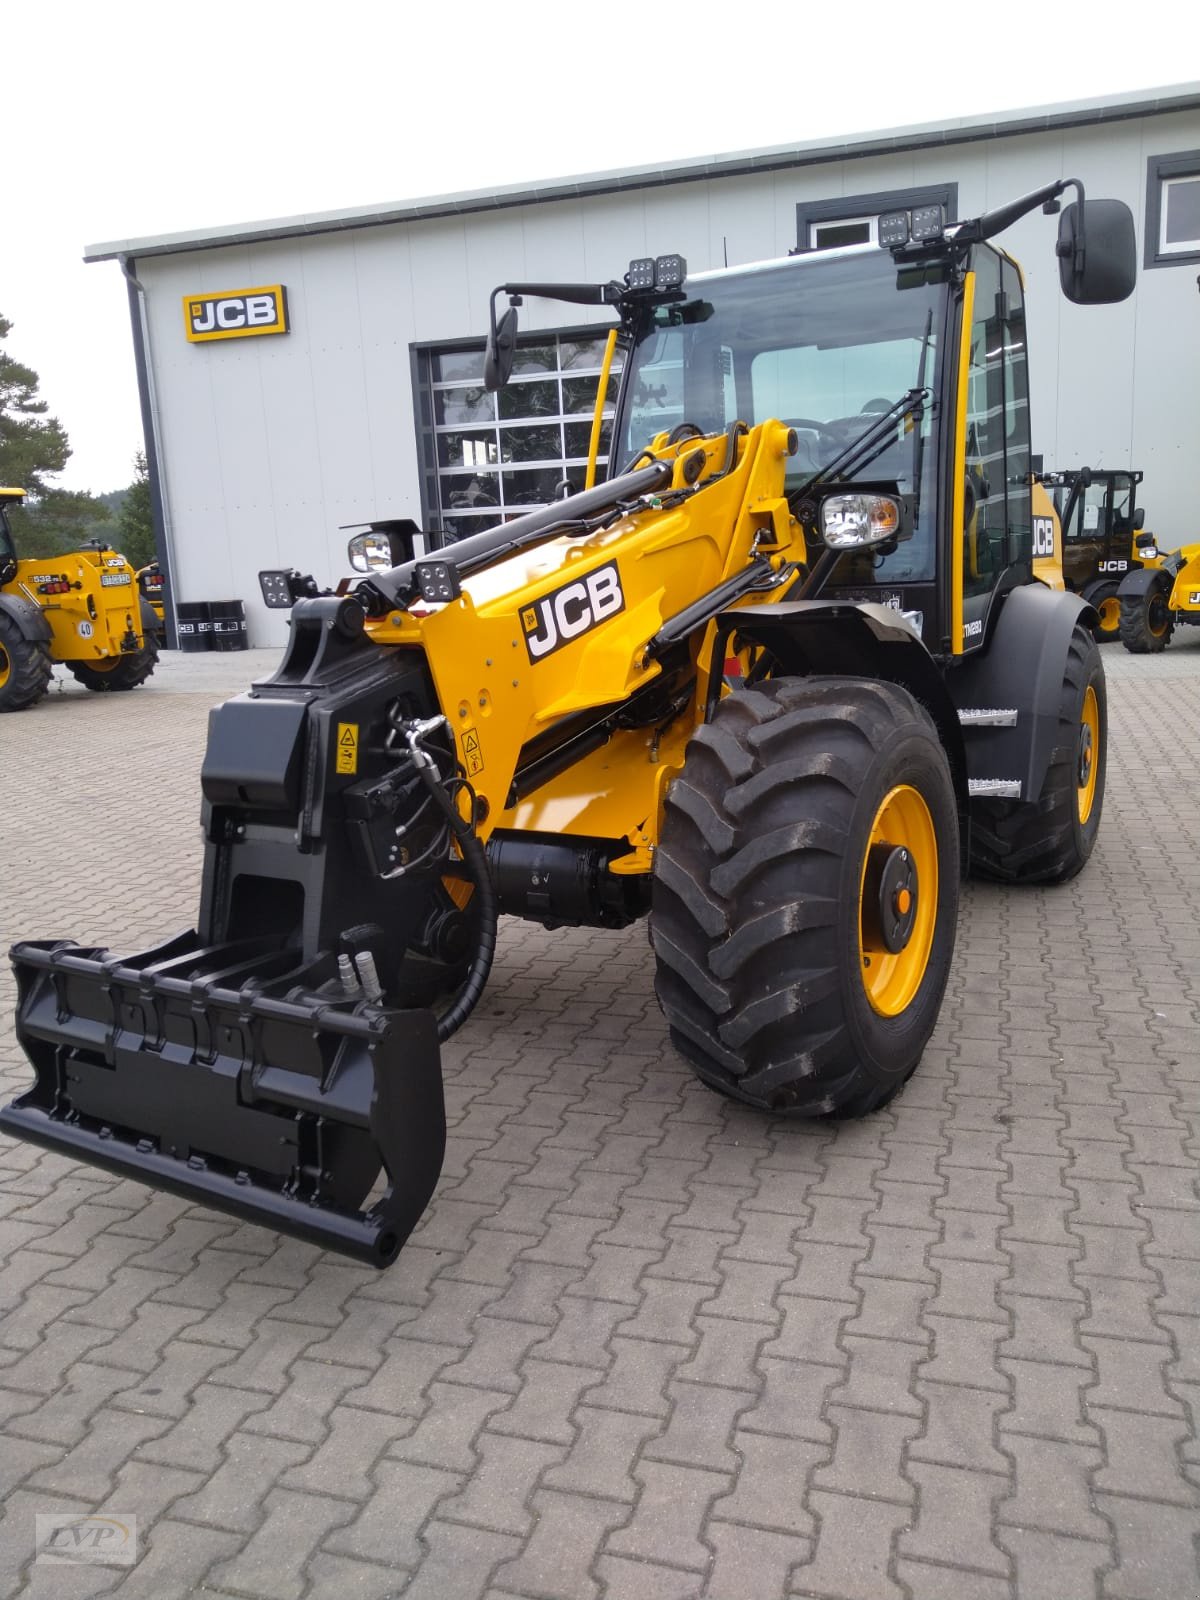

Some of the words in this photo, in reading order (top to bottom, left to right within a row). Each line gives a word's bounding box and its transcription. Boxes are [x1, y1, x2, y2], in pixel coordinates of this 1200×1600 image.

[193, 295, 276, 331] JCB
[1098, 560, 1128, 572] JCB
[527, 566, 623, 657] JCB
[81, 625, 91, 636] 40
